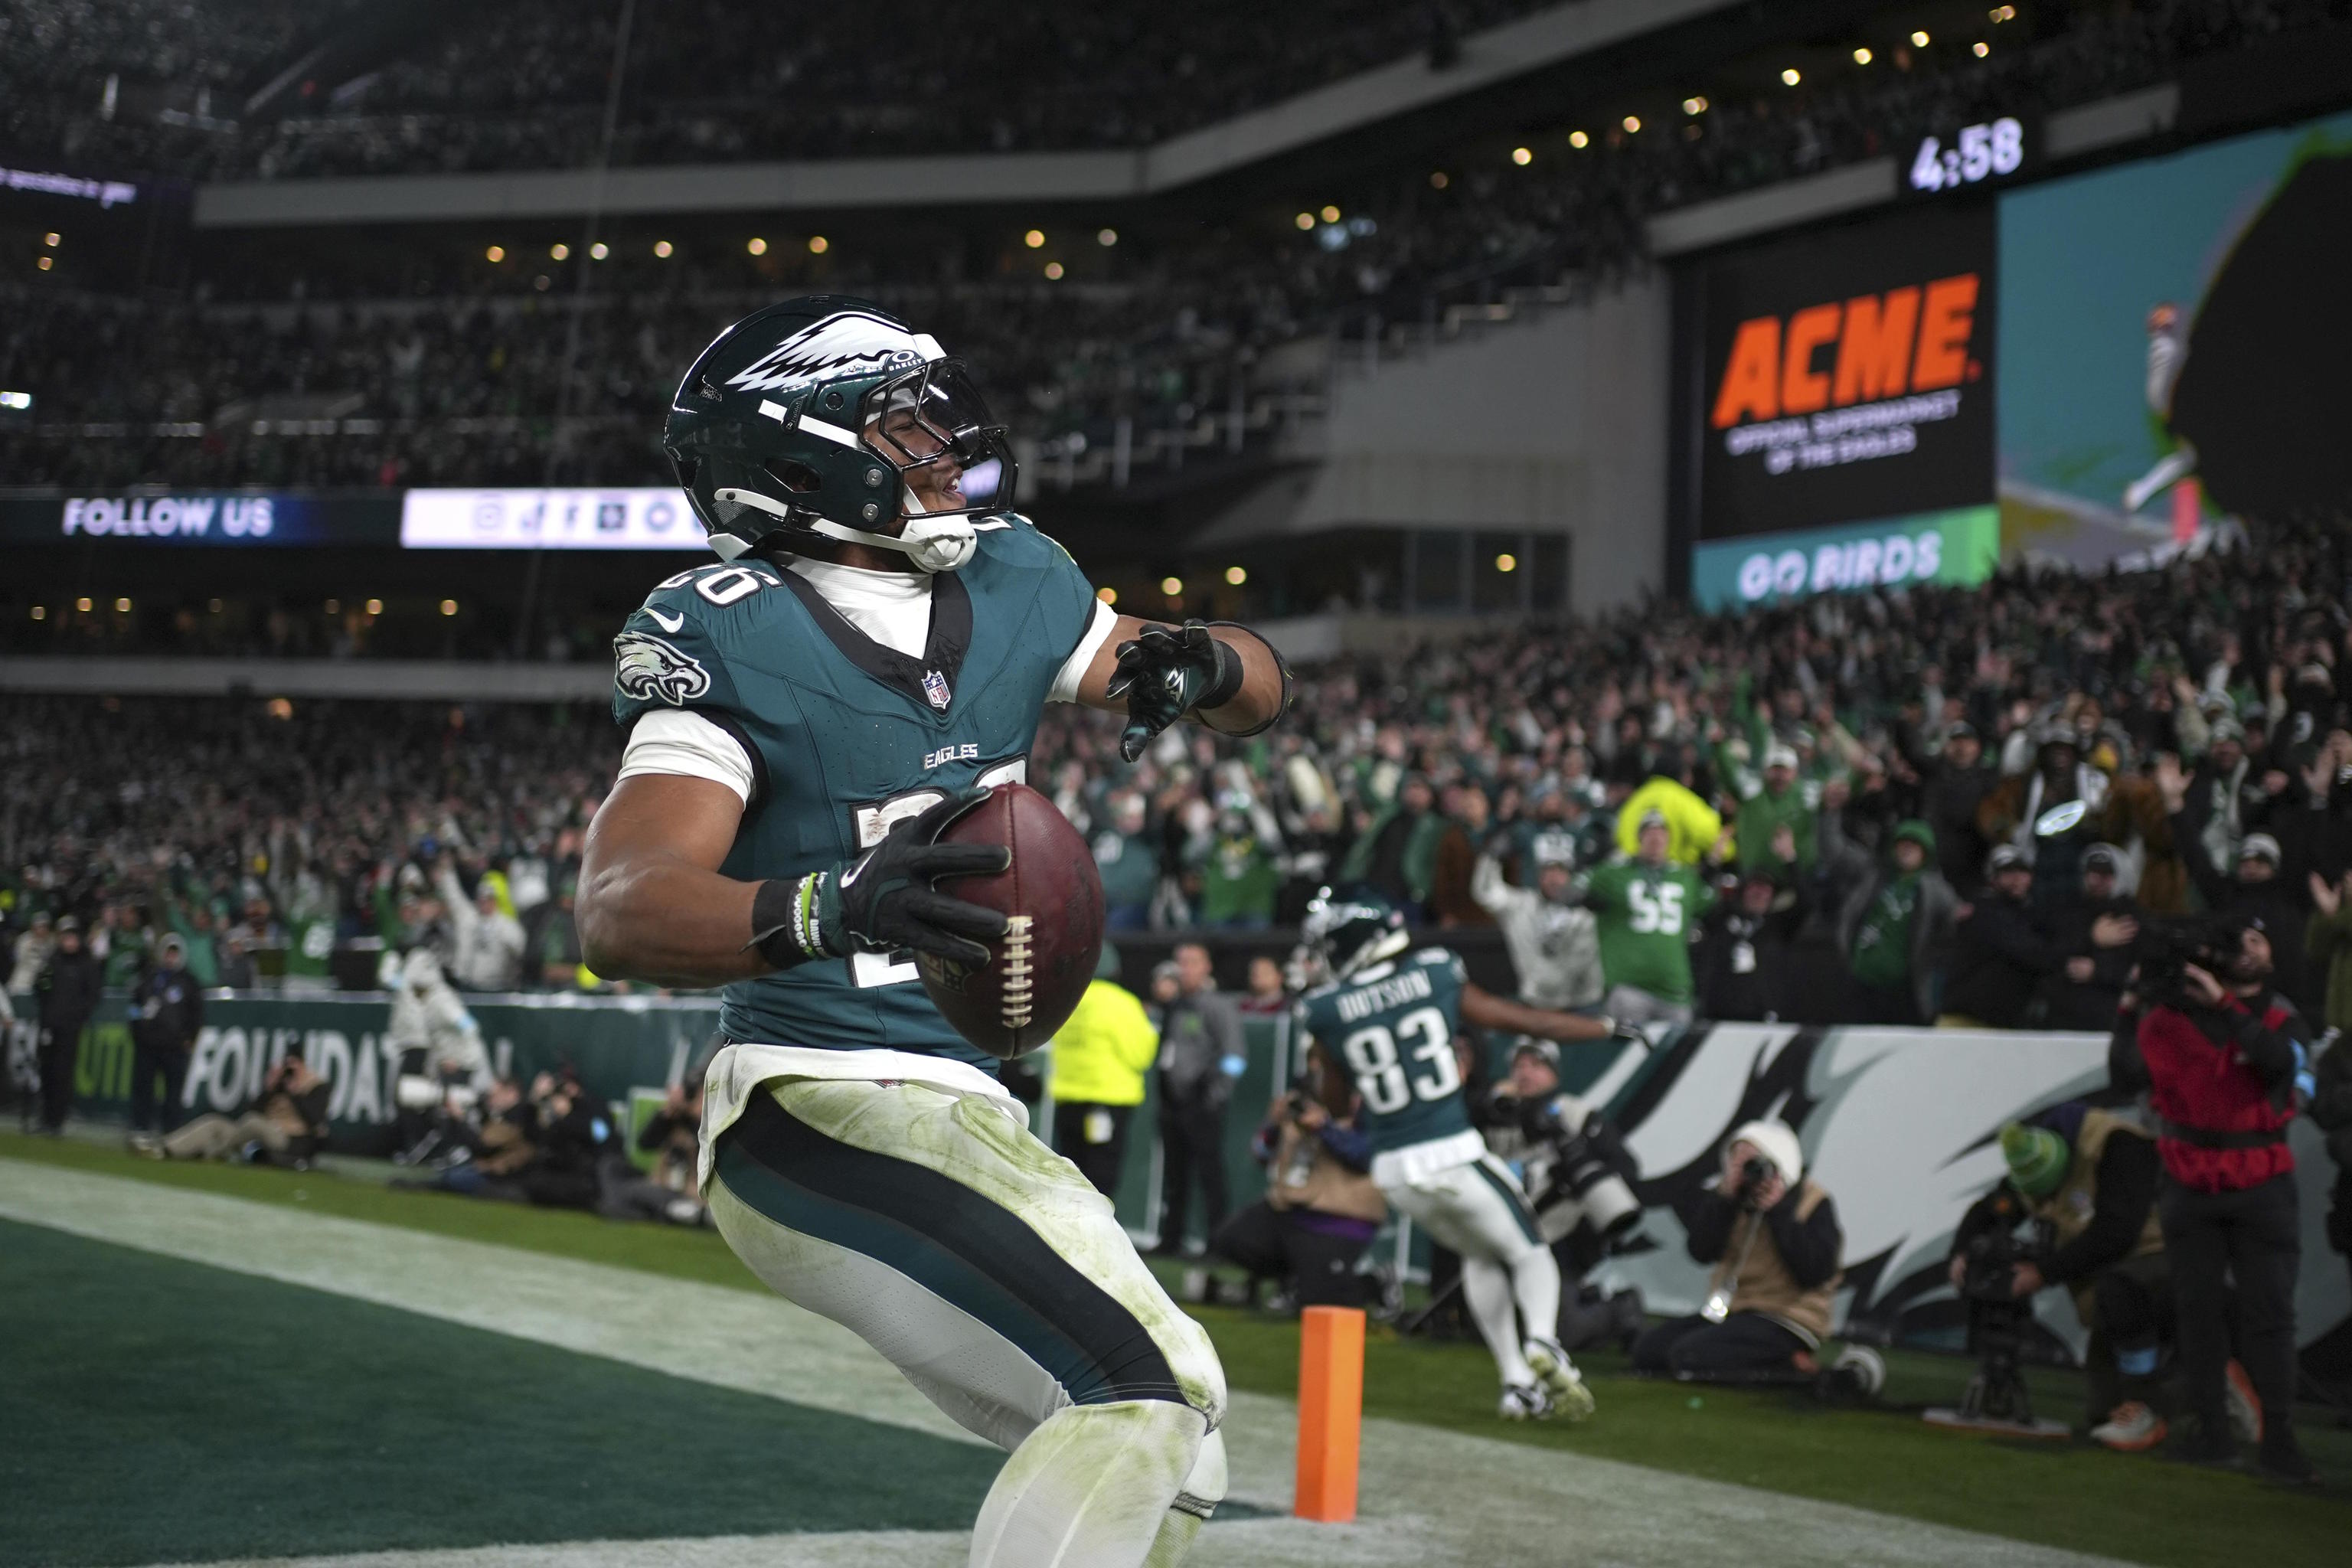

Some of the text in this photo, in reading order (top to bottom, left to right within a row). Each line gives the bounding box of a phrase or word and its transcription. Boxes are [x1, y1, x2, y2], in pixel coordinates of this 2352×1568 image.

[1911, 117, 2024, 192] 4:58
[888, 358, 923, 371] OAKLEY
[1712, 272, 1979, 428] ACME
[63, 497, 273, 537] FOLLOW US
[1739, 530, 1943, 600] GO BIRDS
[929, 686, 948, 702] NFL
[924, 743, 978, 769] EAGLES
[1626, 879, 1684, 935] 55
[1344, 1006, 1460, 1115] 83
